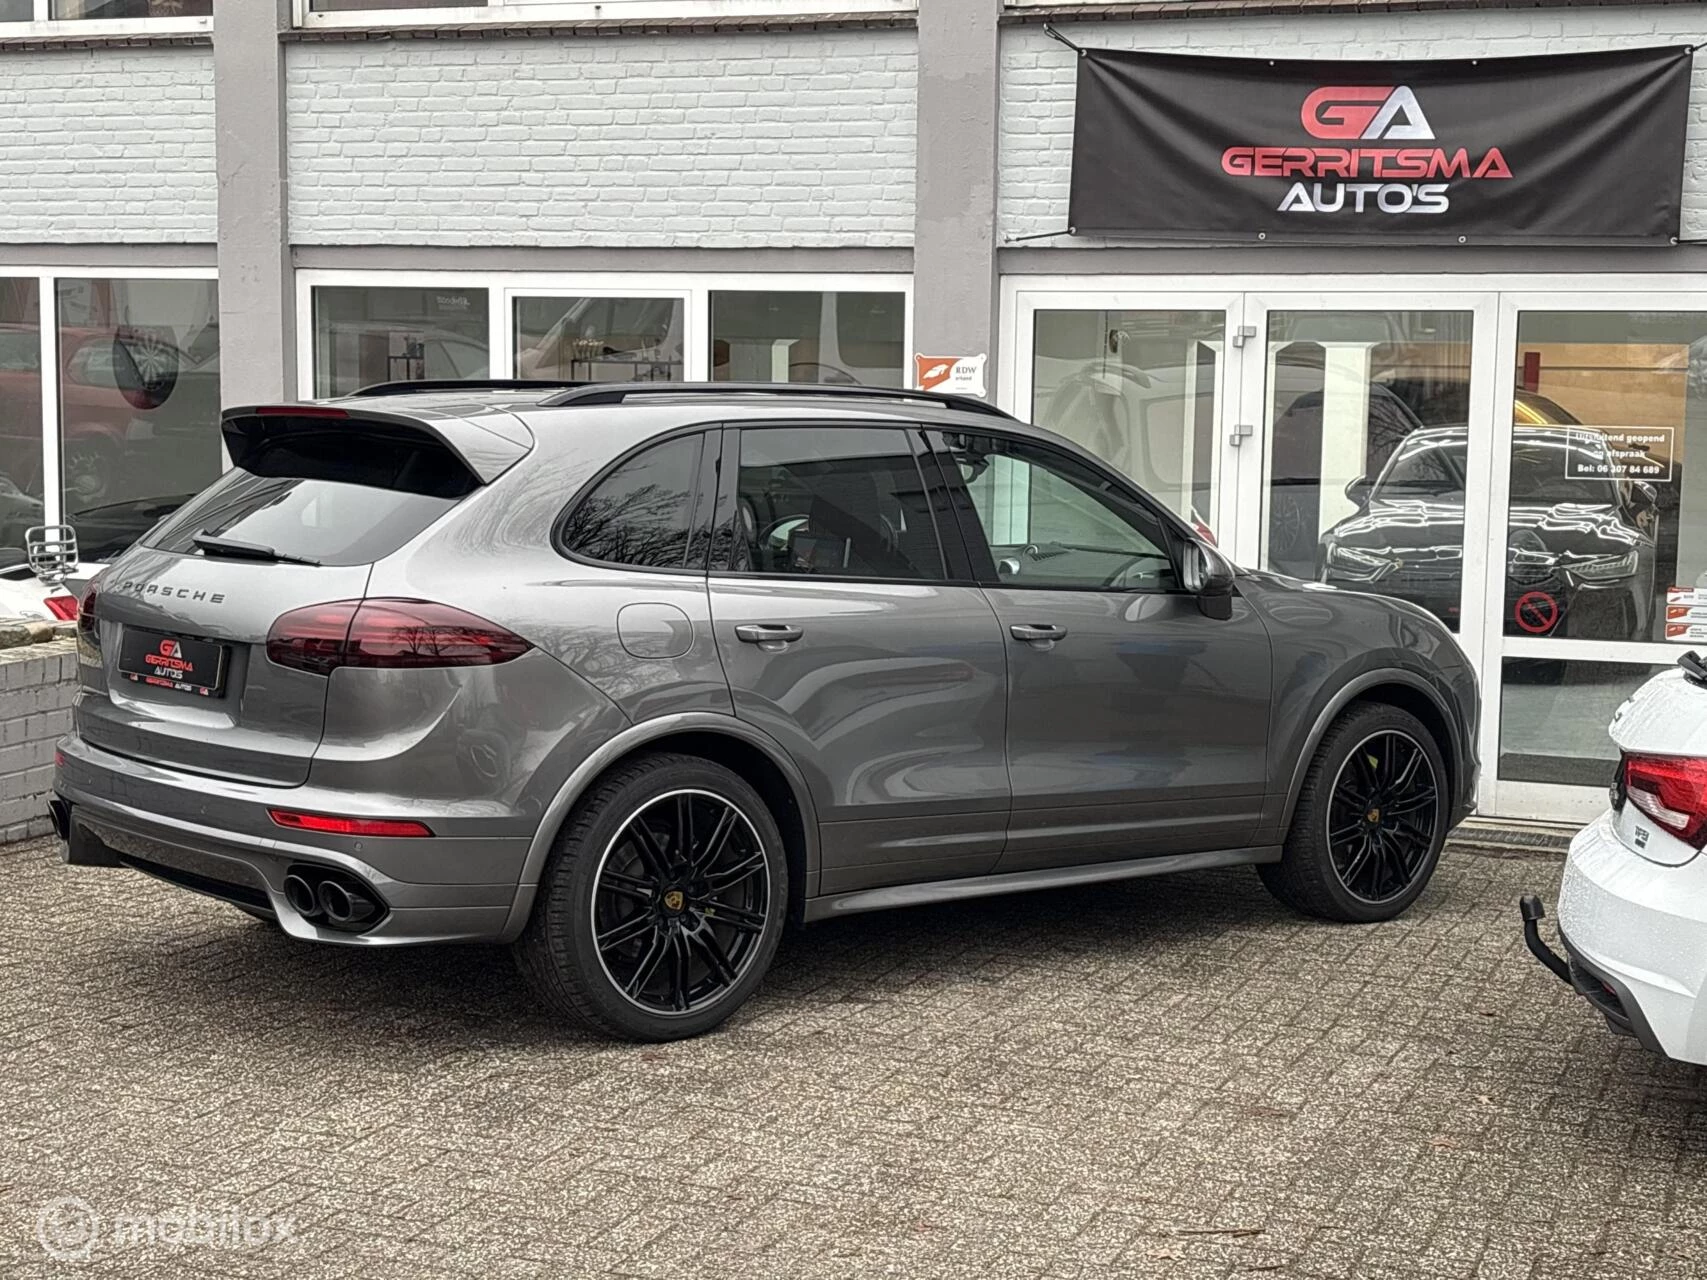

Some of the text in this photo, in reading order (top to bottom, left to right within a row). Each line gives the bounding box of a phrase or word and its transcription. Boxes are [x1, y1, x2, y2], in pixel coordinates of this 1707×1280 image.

[1220, 146, 1513, 179] GERRITSMA
[1277, 182, 1450, 213] AUTO'S
[956, 366, 977, 374] RDW
[1626, 434, 1665, 444] geopend
[1577, 464, 1595, 472] Bel:
[1643, 466, 1660, 474] 689
[122, 581, 226, 604] PORSCHE
[145, 654, 194, 672] GERRITSMA
